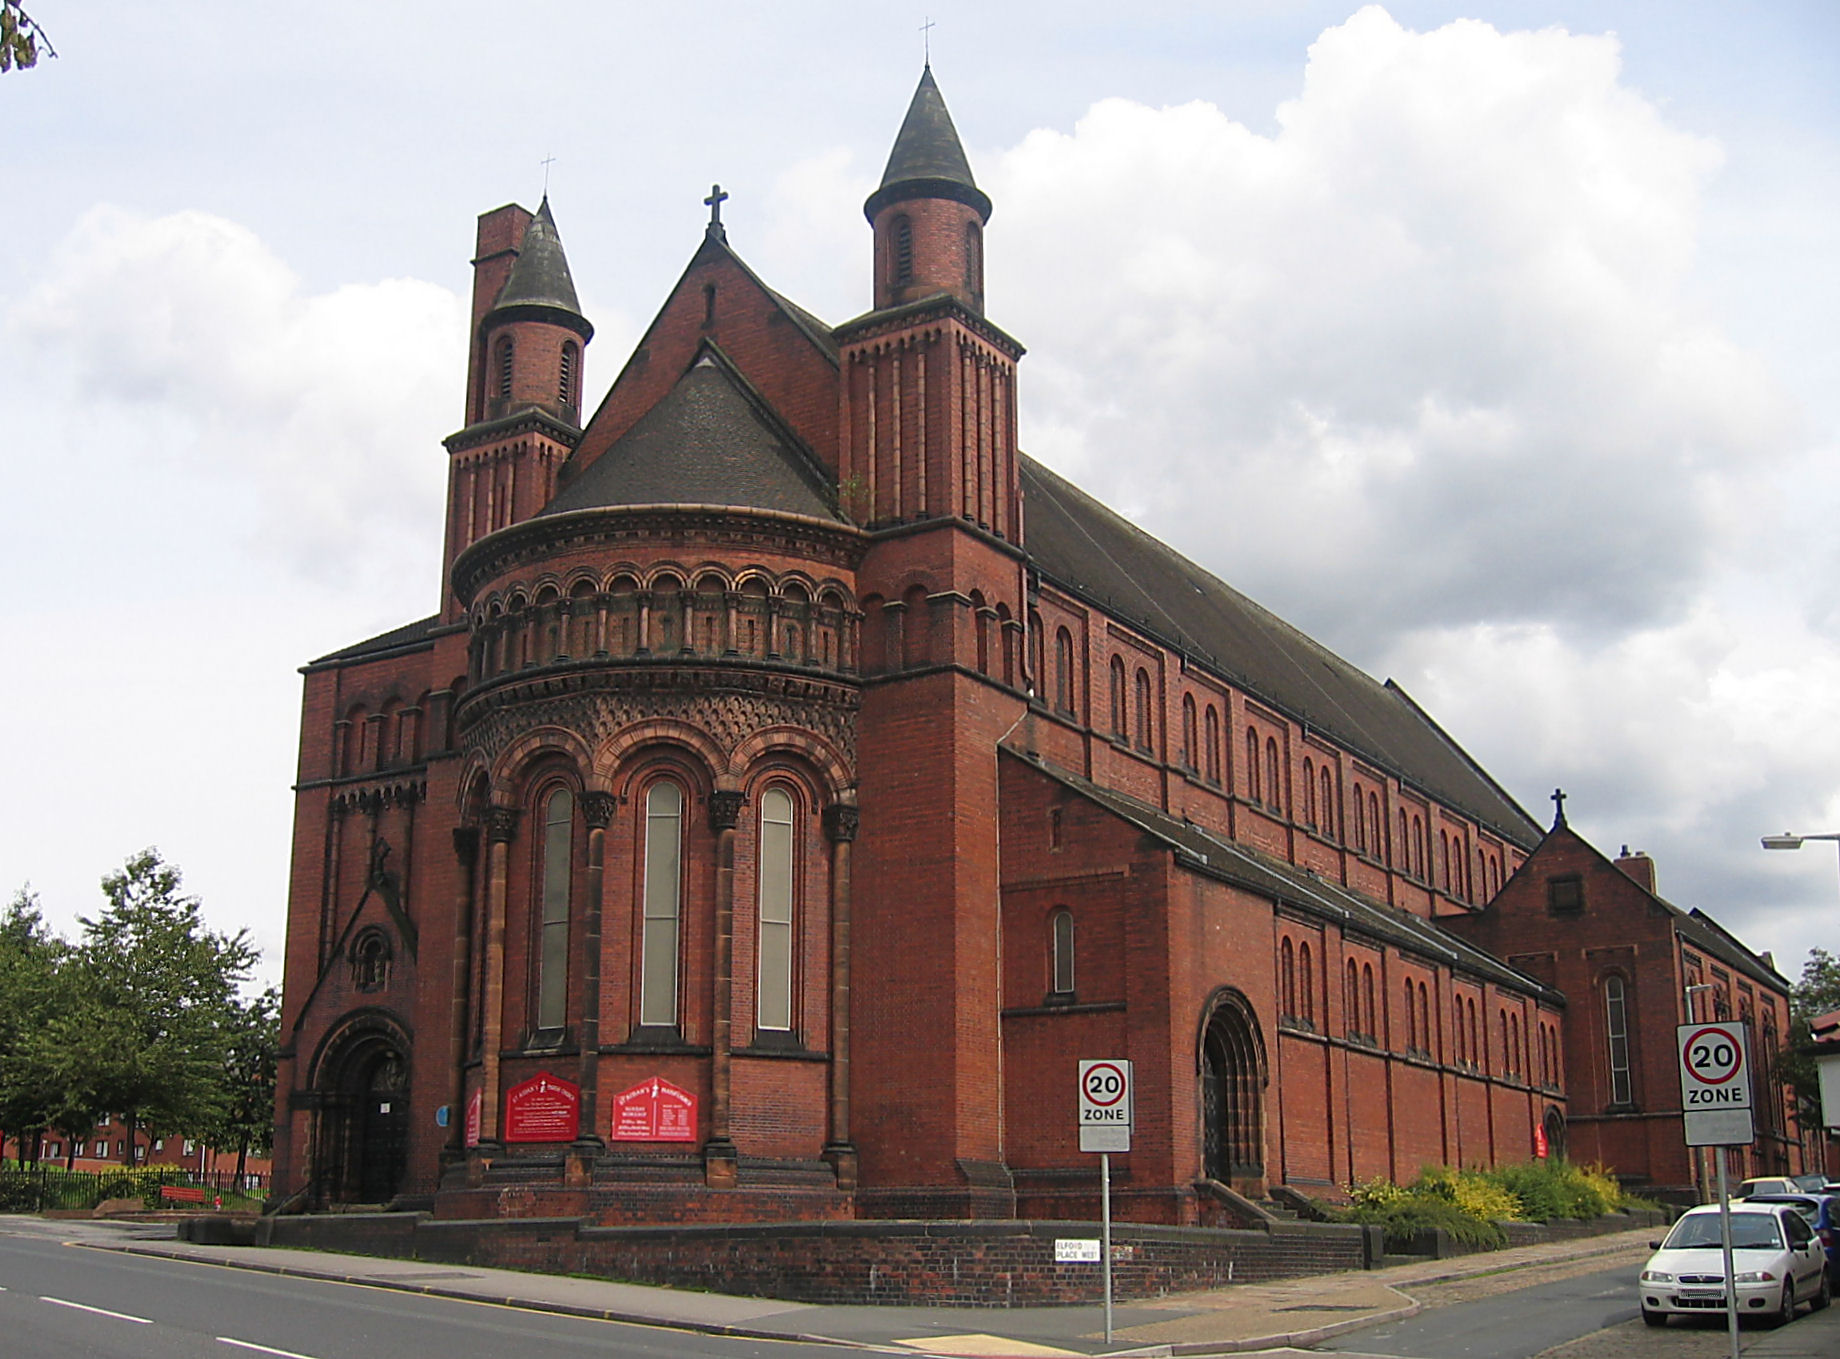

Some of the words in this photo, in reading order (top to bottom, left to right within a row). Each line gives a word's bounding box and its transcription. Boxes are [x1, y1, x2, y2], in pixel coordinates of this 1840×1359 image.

[1693, 1044, 1733, 1068] 20
[1090, 1076, 1119, 1093] 20
[1689, 1088, 1742, 1104] ZONE
[1084, 1109, 1124, 1120] ZONE
